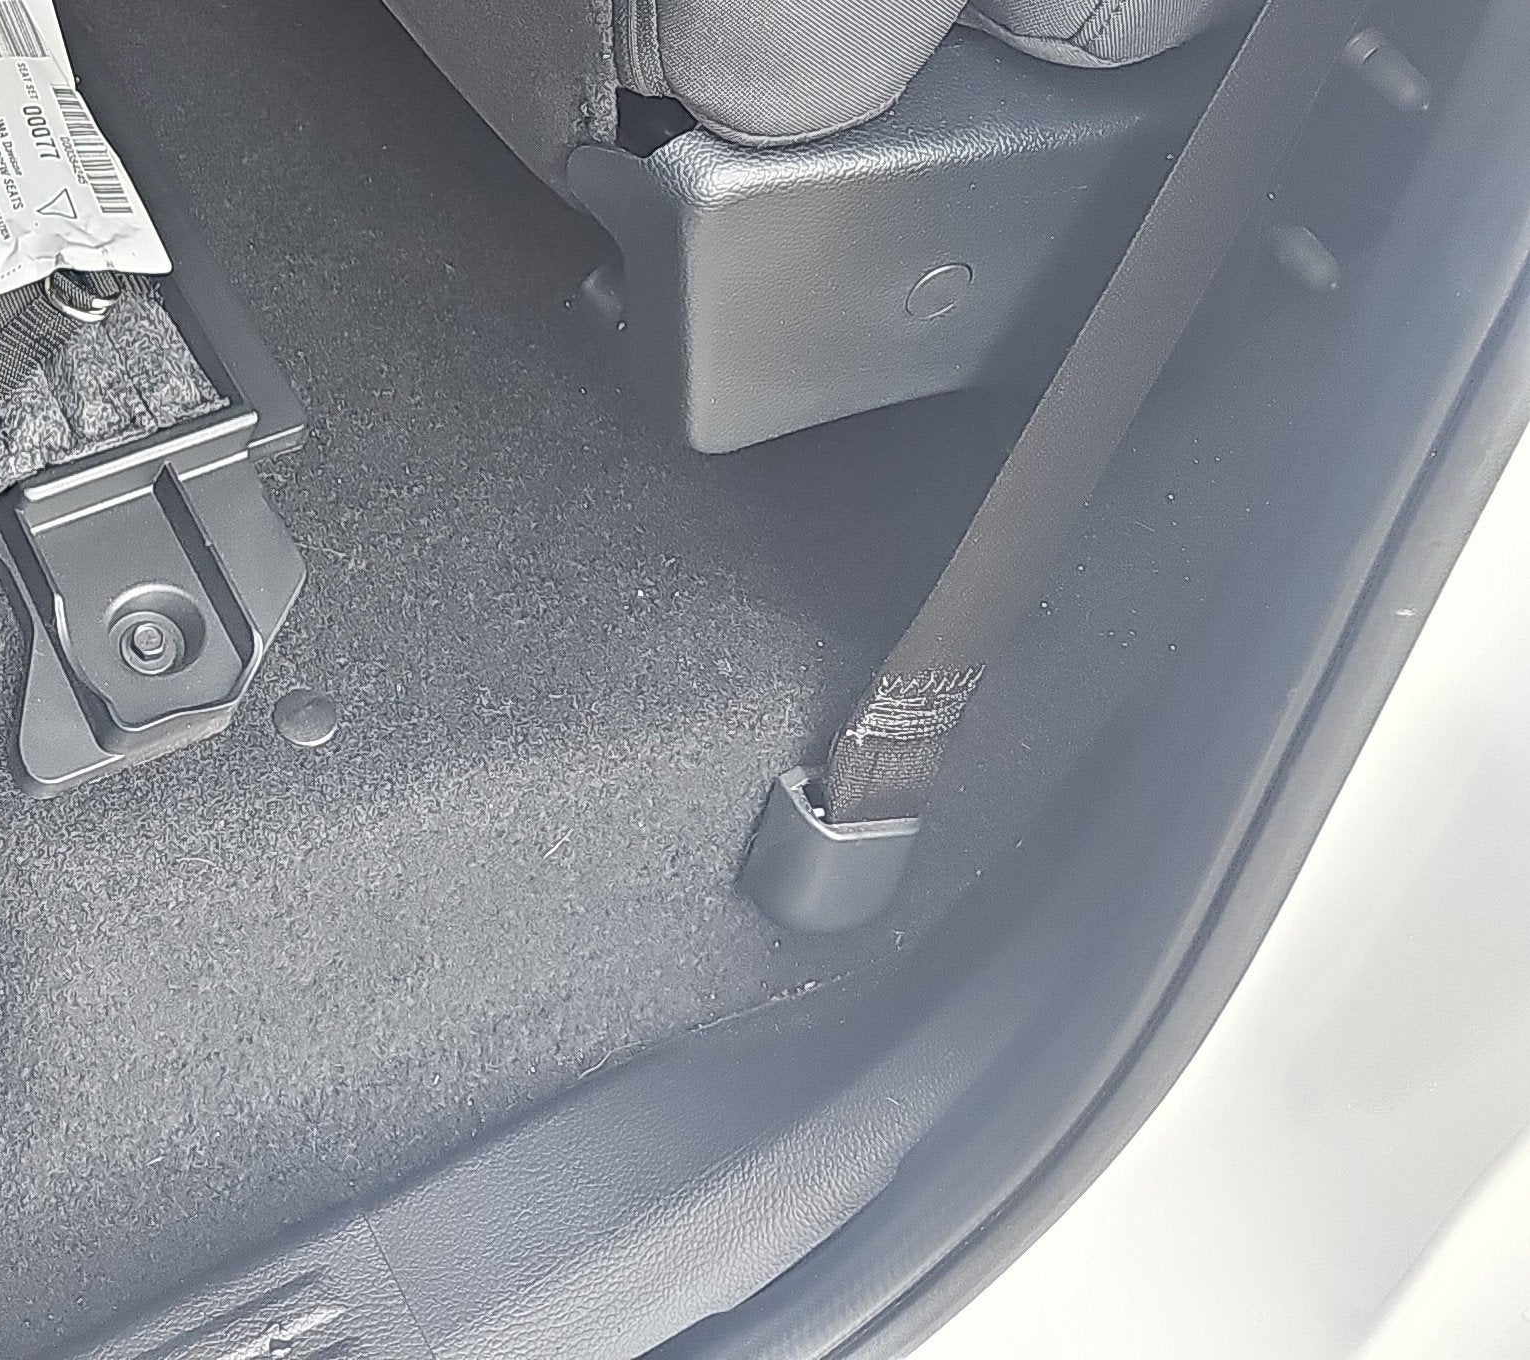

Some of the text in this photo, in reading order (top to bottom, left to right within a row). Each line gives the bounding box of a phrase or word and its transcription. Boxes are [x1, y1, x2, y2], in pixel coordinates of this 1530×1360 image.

[17, 62, 61, 159] SEAT SET 00077
[4, 178, 24, 210] SEATS
